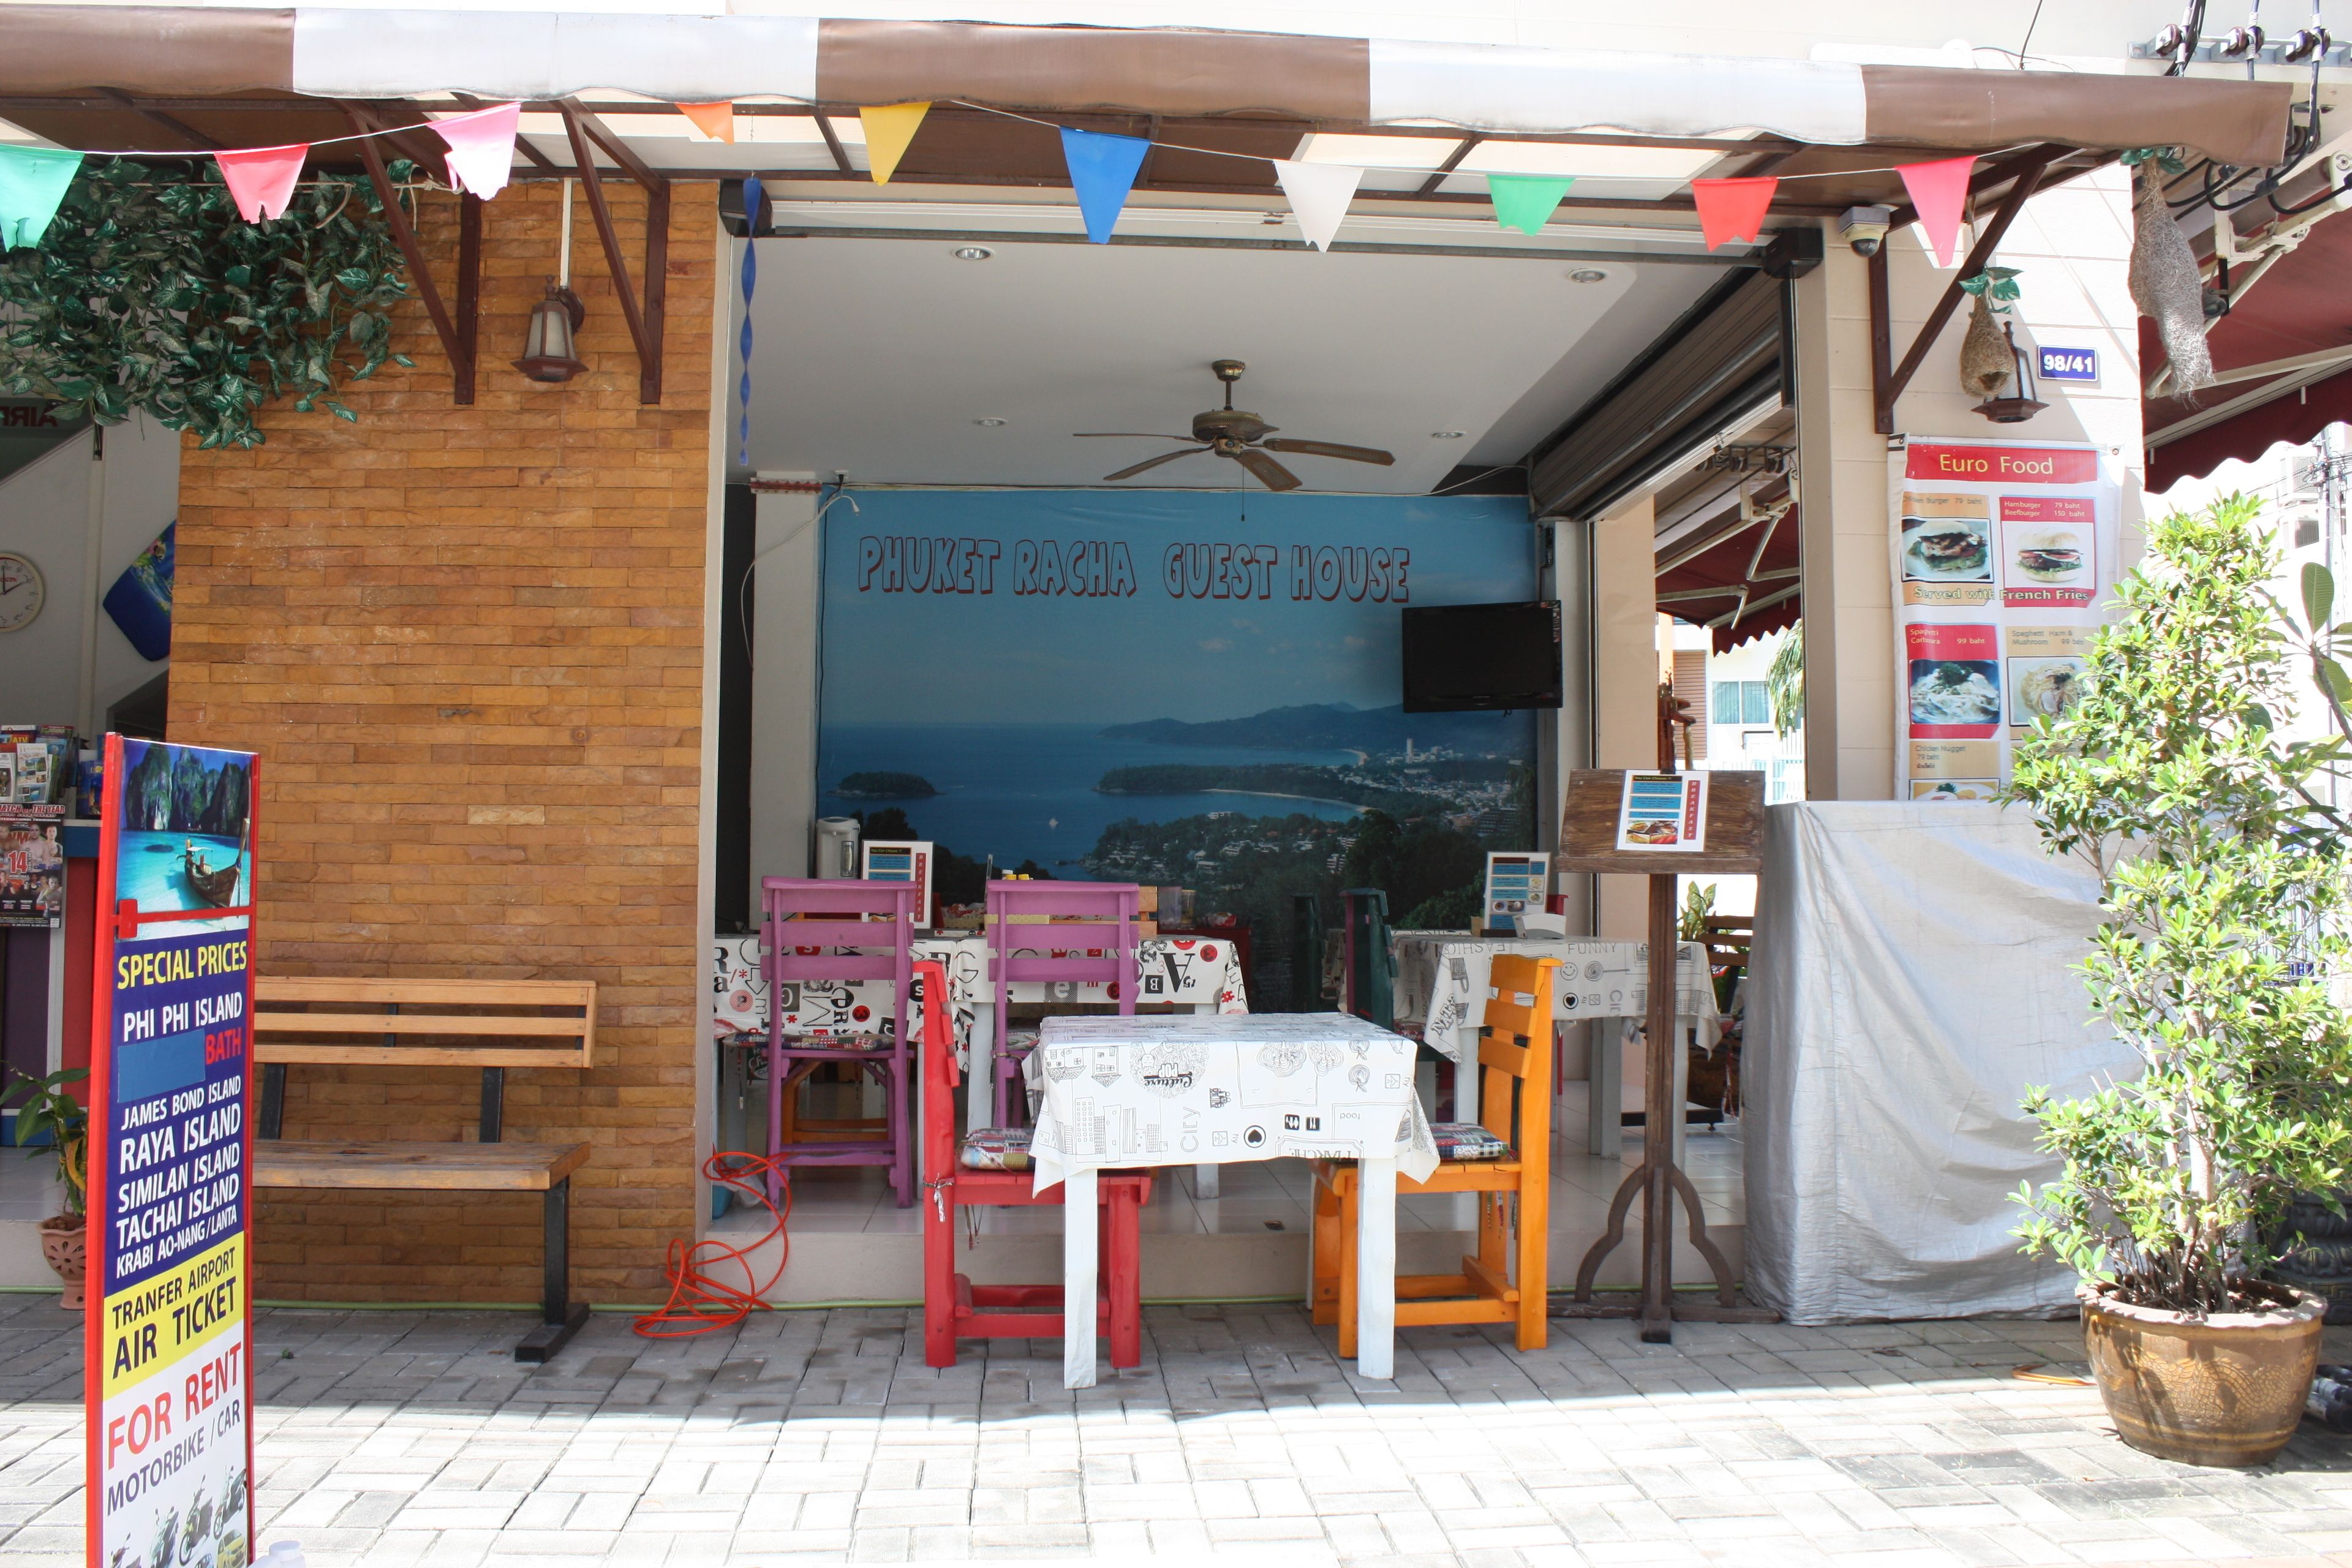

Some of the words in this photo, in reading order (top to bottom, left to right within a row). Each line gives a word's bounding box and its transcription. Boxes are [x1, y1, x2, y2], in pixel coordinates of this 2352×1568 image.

[2043, 354, 2092, 372] 98/41
[1939, 454, 1988, 473] Euro
[2000, 456, 2053, 474] Food
[858, 536, 1000, 594] PHUKET
[1014, 540, 1136, 597] RACHA
[1163, 543, 1277, 600] GUEST
[1291, 545, 1409, 603] HOUSE
[1913, 587, 1961, 599] Served
[1966, 588, 1995, 600] with
[1999, 589, 2051, 600] French
[2056, 590, 2088, 601] Fries
[32, 804, 47, 813] THE
[47, 805, 65, 813] YEAR
[8, 850, 28, 873] 14
[118, 948, 194, 990] SPECIAL
[198, 941, 247, 977] PRICES
[1567, 943, 1616, 954] FUNNY
[124, 1008, 154, 1042] PHI
[162, 1002, 189, 1036] PHI
[195, 992, 243, 1028] ISLAND
[205, 1027, 241, 1066] BATH
[1158, 1063, 1178, 1077] POP
[121, 1098, 167, 1131] JAMES
[172, 1088, 204, 1115] BOND
[208, 1076, 241, 1104] ISLAND
[1144, 1076, 1193, 1088] Culture
[119, 1125, 175, 1175] RAYA
[184, 1102, 241, 1152] ISLAND
[118, 1163, 187, 1213] SIMILAN
[194, 1143, 239, 1183] ISLAND
[116, 1197, 183, 1250] TACHAI
[189, 1173, 239, 1220] ISLAND
[116, 1243, 154, 1279] KRABI
[112, 1276, 183, 1330] TRANFER
[188, 1246, 235, 1292] AIRPORT
[112, 1323, 157, 1380] AIR
[172, 1276, 236, 1345] TICKET
[107, 1392, 172, 1471] FOR
[185, 1341, 241, 1422] RENT
[107, 1427, 204, 1517] MOTORBIKE
